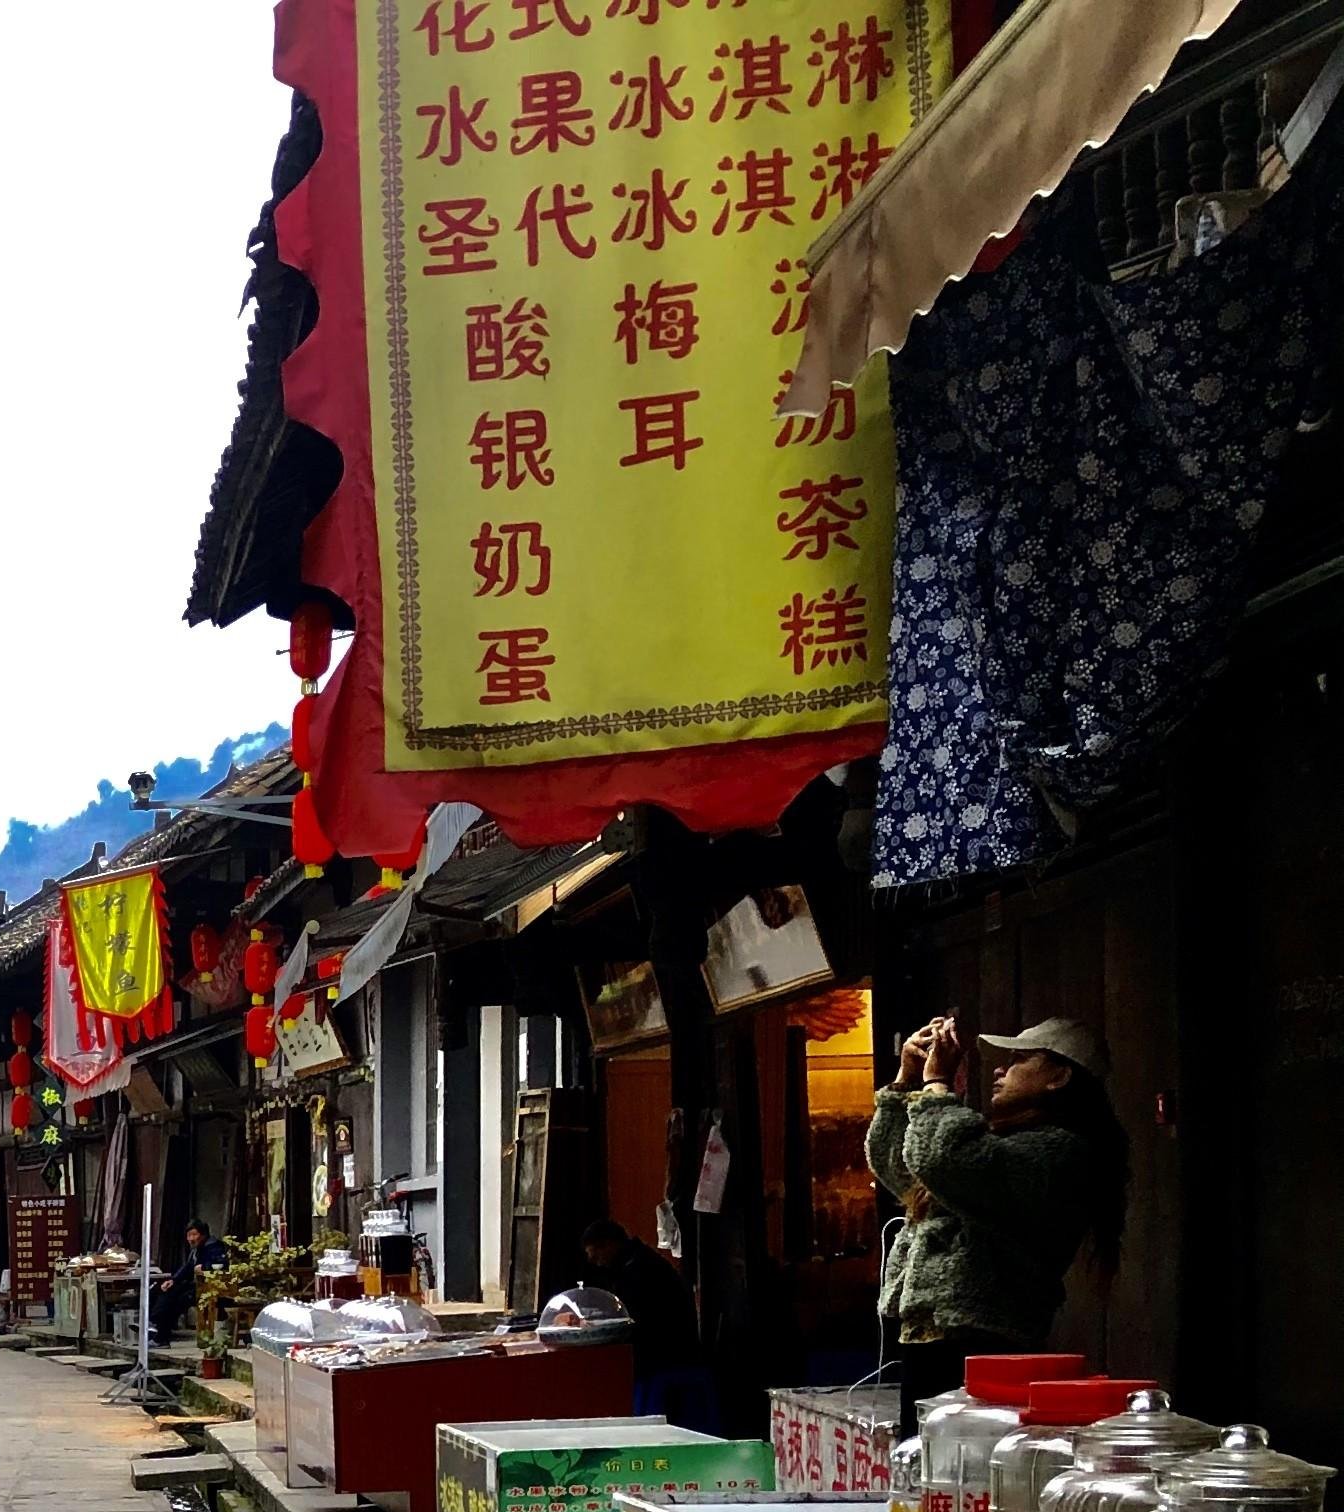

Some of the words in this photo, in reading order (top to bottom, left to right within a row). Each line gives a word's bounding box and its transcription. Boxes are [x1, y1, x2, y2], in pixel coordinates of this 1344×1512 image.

[416, 15, 895, 166] 水果冰淇淋
[471, 472, 867, 598] 奶茶
[474, 583, 869, 707] 蛋糕
[605, 1458, 672, 1472] 价目表
[716, 1479, 760, 1490] 10元
